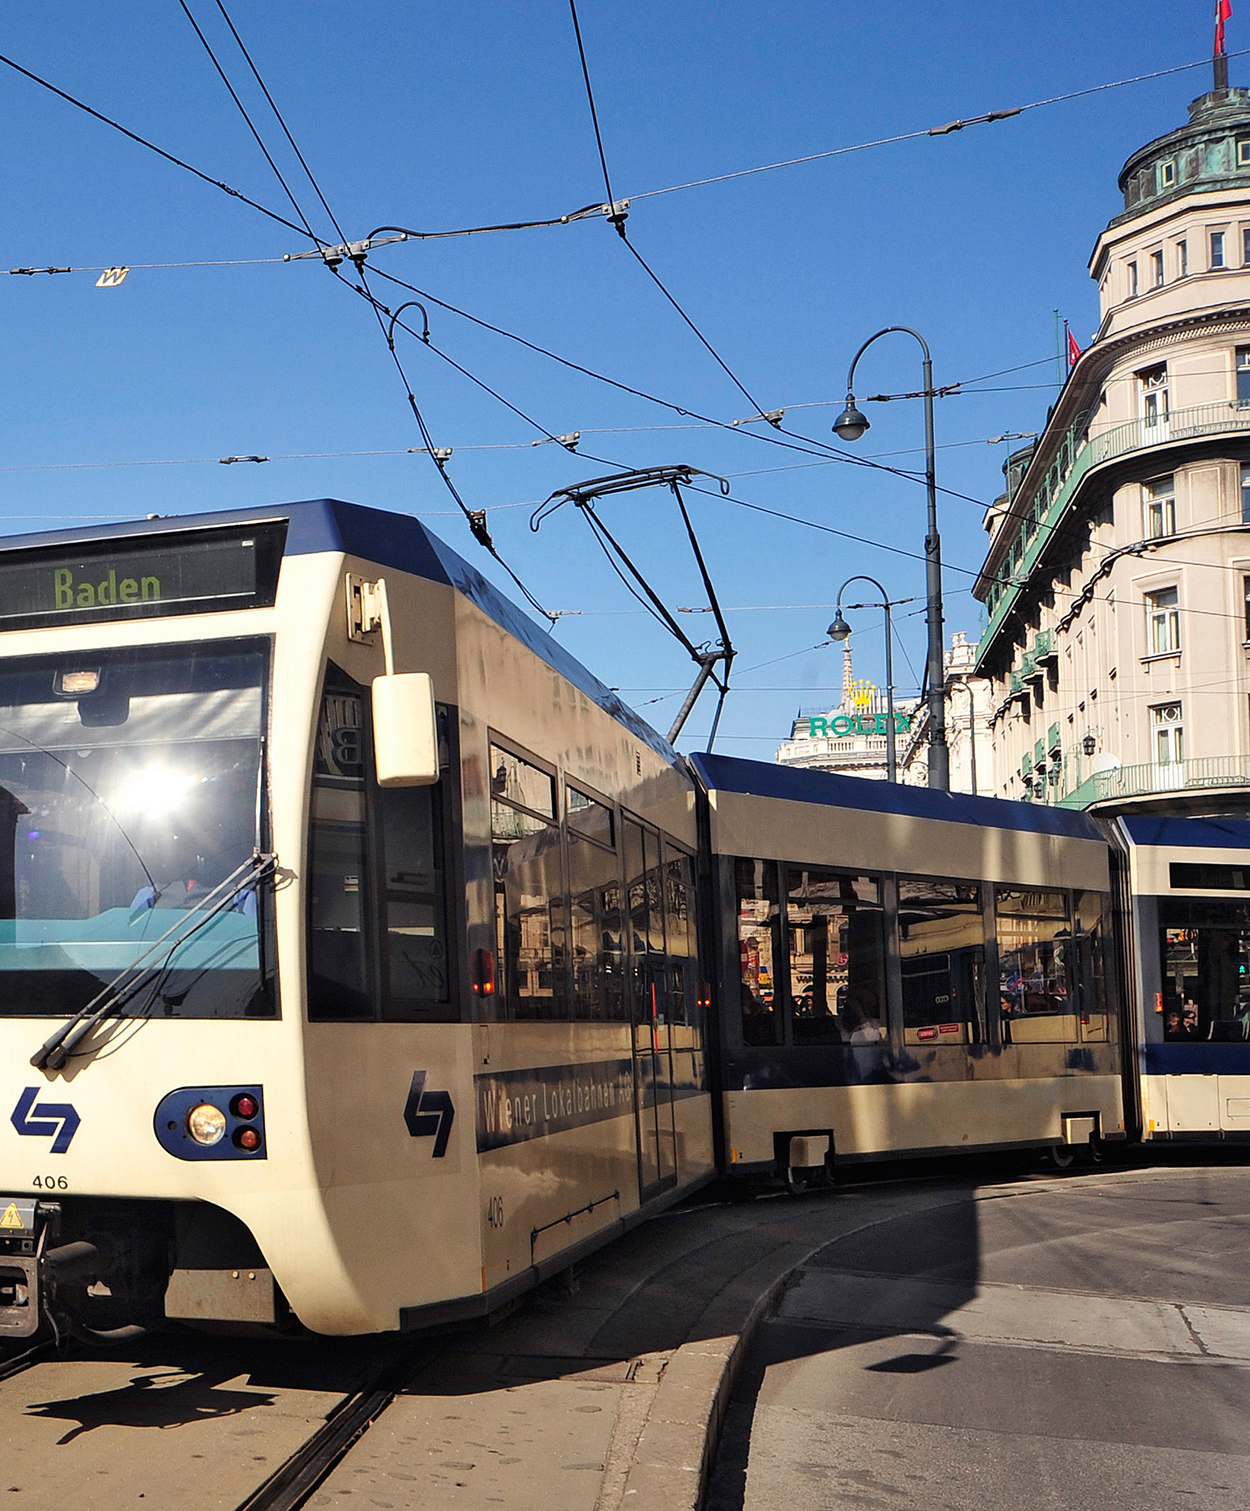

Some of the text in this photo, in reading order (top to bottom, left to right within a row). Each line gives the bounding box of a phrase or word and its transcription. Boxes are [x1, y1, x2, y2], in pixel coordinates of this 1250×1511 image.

[54, 568, 162, 610] Baden
[809, 713, 911, 737] ROLEX
[483, 1089, 537, 1133] Wiener
[543, 1077, 615, 1120] Lokalbahnen
[32, 1175, 69, 1190] 406
[487, 1196, 504, 1229] 406
